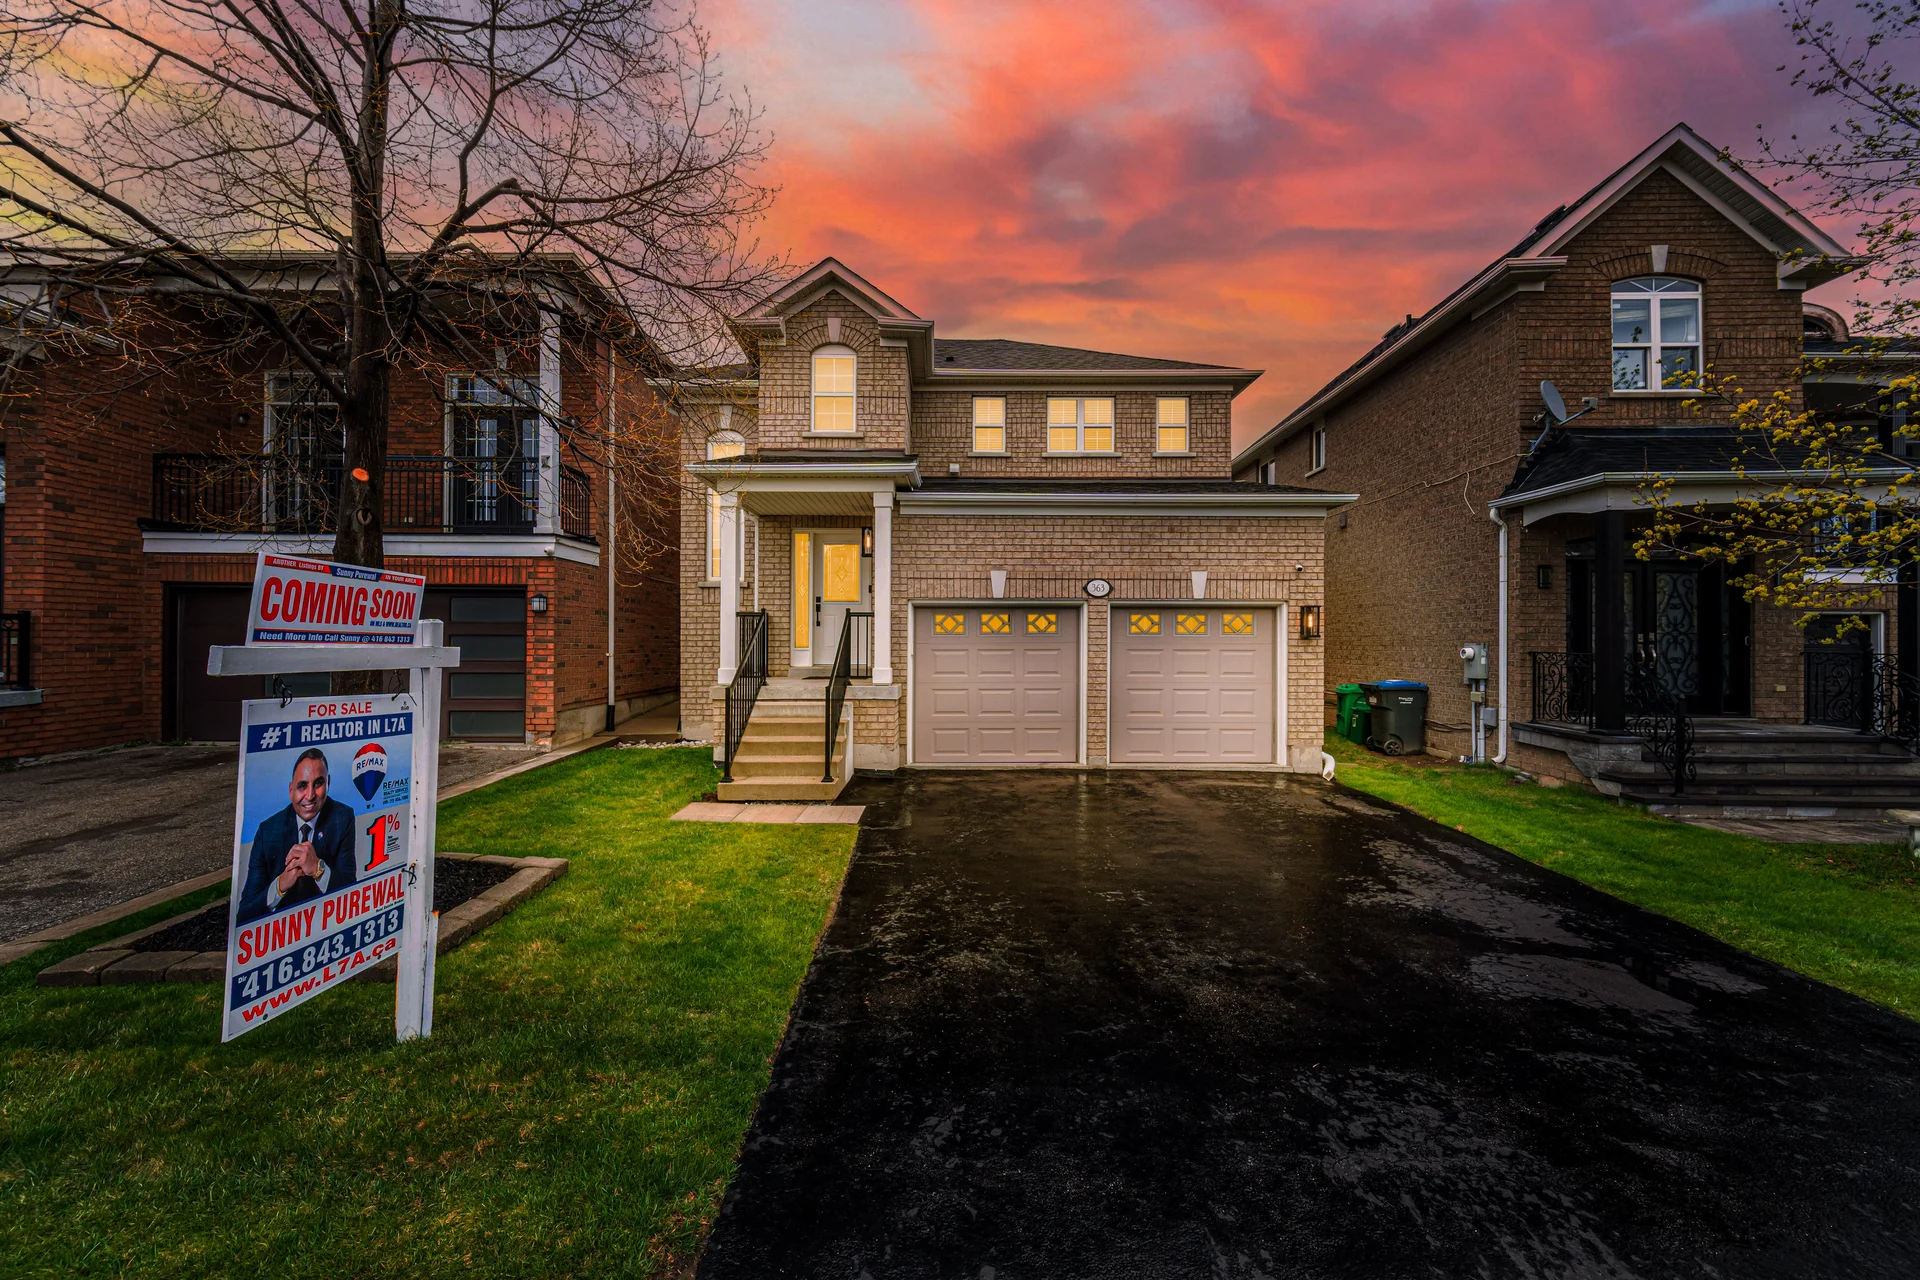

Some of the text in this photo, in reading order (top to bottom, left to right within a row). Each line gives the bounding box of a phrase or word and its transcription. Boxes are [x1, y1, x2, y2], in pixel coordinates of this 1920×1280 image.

[272, 557, 297, 568] ANOTHER
[336, 567, 377, 581] Sunny Purewal
[391, 575, 404, 583] YOUR
[1092, 584, 1105, 592] 363
[261, 577, 417, 626] COMING SOON
[259, 631, 283, 641] Need
[284, 632, 306, 641] More
[308, 633, 324, 641] Info
[324, 633, 339, 641] Call
[340, 634, 360, 643] Sunny
[361, 635, 370, 643] @
[383, 635, 396, 643] 843
[308, 701, 372, 717] FOR SALE
[260, 725, 292, 748] #1
[301, 720, 363, 743] REALTOR
[367, 719, 380, 735] IN
[356, 757, 384, 771] RE/MAX
[382, 777, 409, 790] RE/MAX
[237, 873, 405, 965] SUNNY PUREWAL
[242, 910, 399, 998] 416.843.1313
[242, 937, 397, 1022] www.L7A.ca
